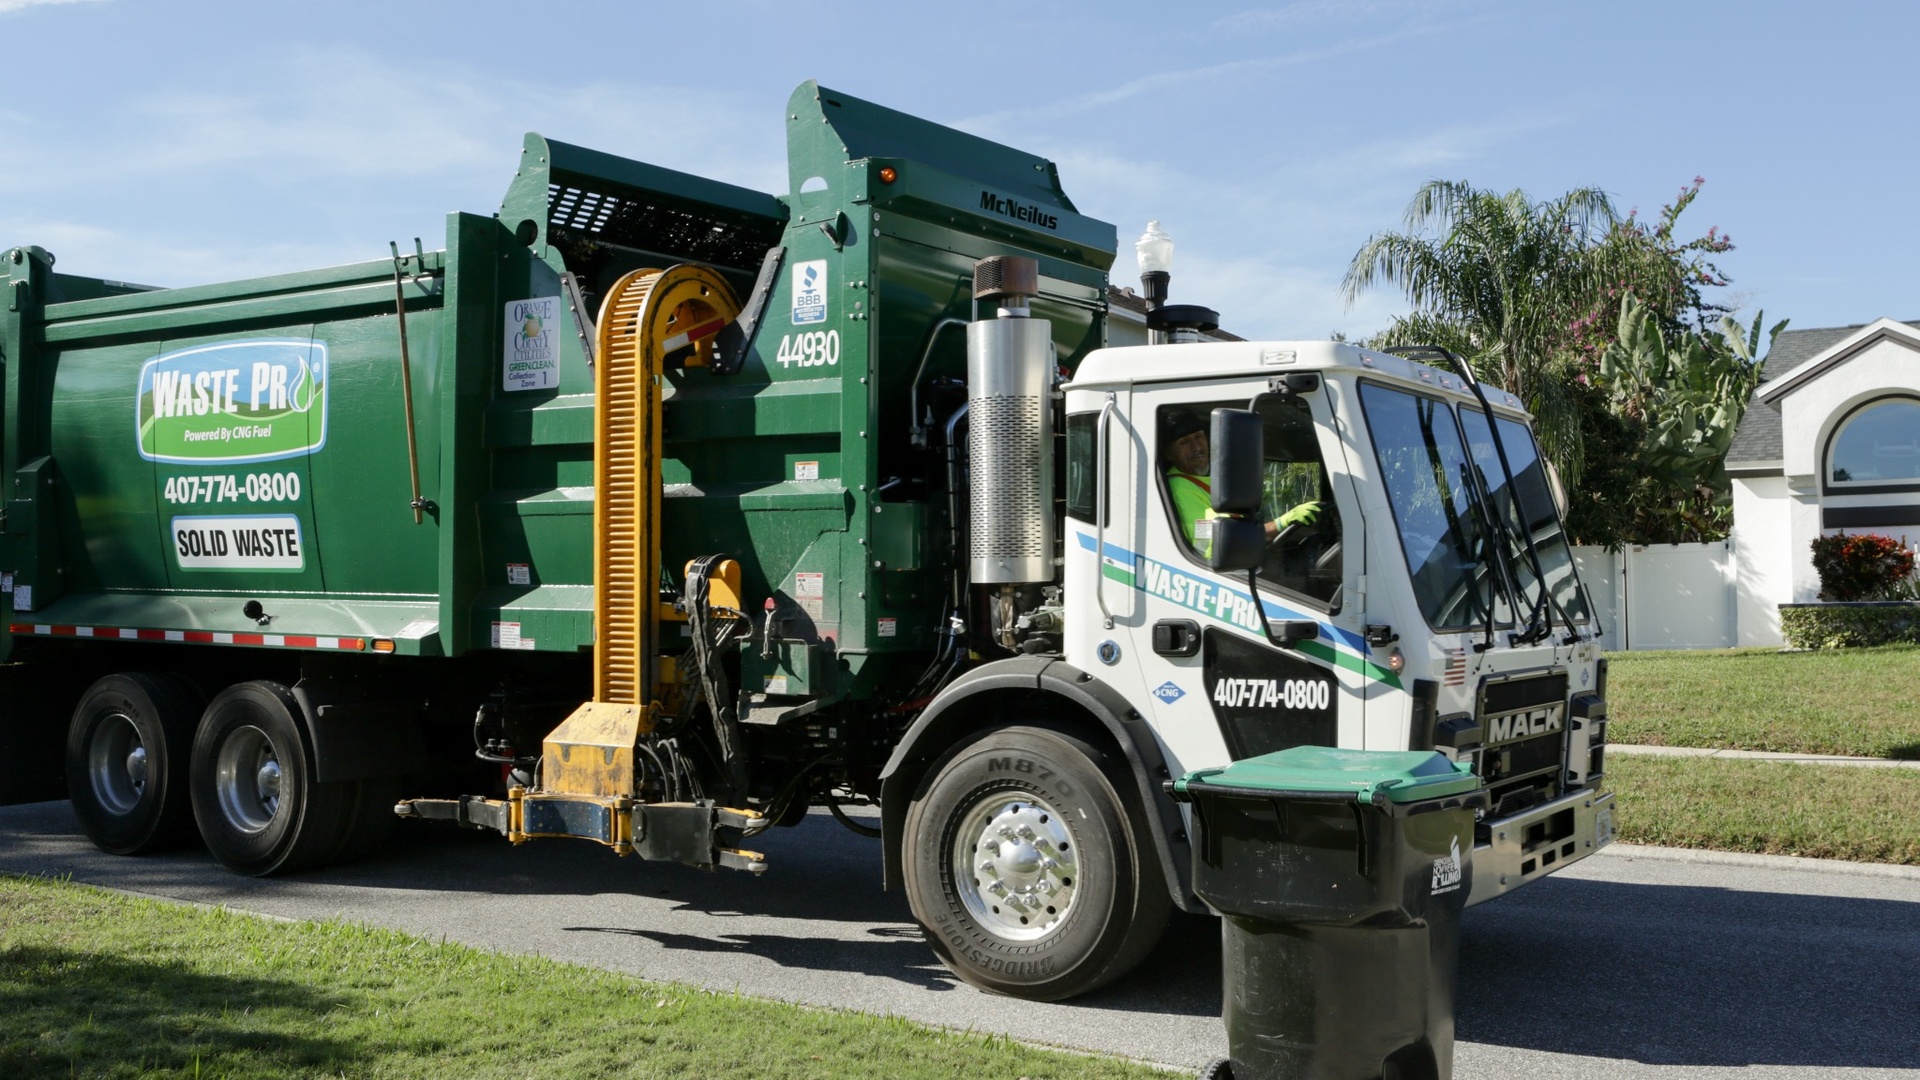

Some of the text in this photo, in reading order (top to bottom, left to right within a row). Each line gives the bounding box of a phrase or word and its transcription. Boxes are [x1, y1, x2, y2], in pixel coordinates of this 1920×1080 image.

[980, 191, 1058, 230] McNeilus
[514, 301, 552, 322] ORANGE
[797, 294, 821, 307] BBB
[514, 329, 552, 352] COUNTY
[776, 329, 840, 368] 44930
[508, 371, 548, 385] Collection 1
[521, 379, 536, 387] Zone
[152, 369, 240, 419] WASTE
[184, 423, 272, 442] Powered By CNG Fuel
[164, 471, 301, 504] 407-774-0800
[177, 528, 299, 557] SOLID WASTE
[1160, 688, 1179, 697] CNG
[1214, 678, 1330, 710] 407-774-0800
[1489, 706, 1561, 743] MACK
[987, 756, 1076, 798] M870
[934, 912, 1058, 977] BRIDGESTONE
